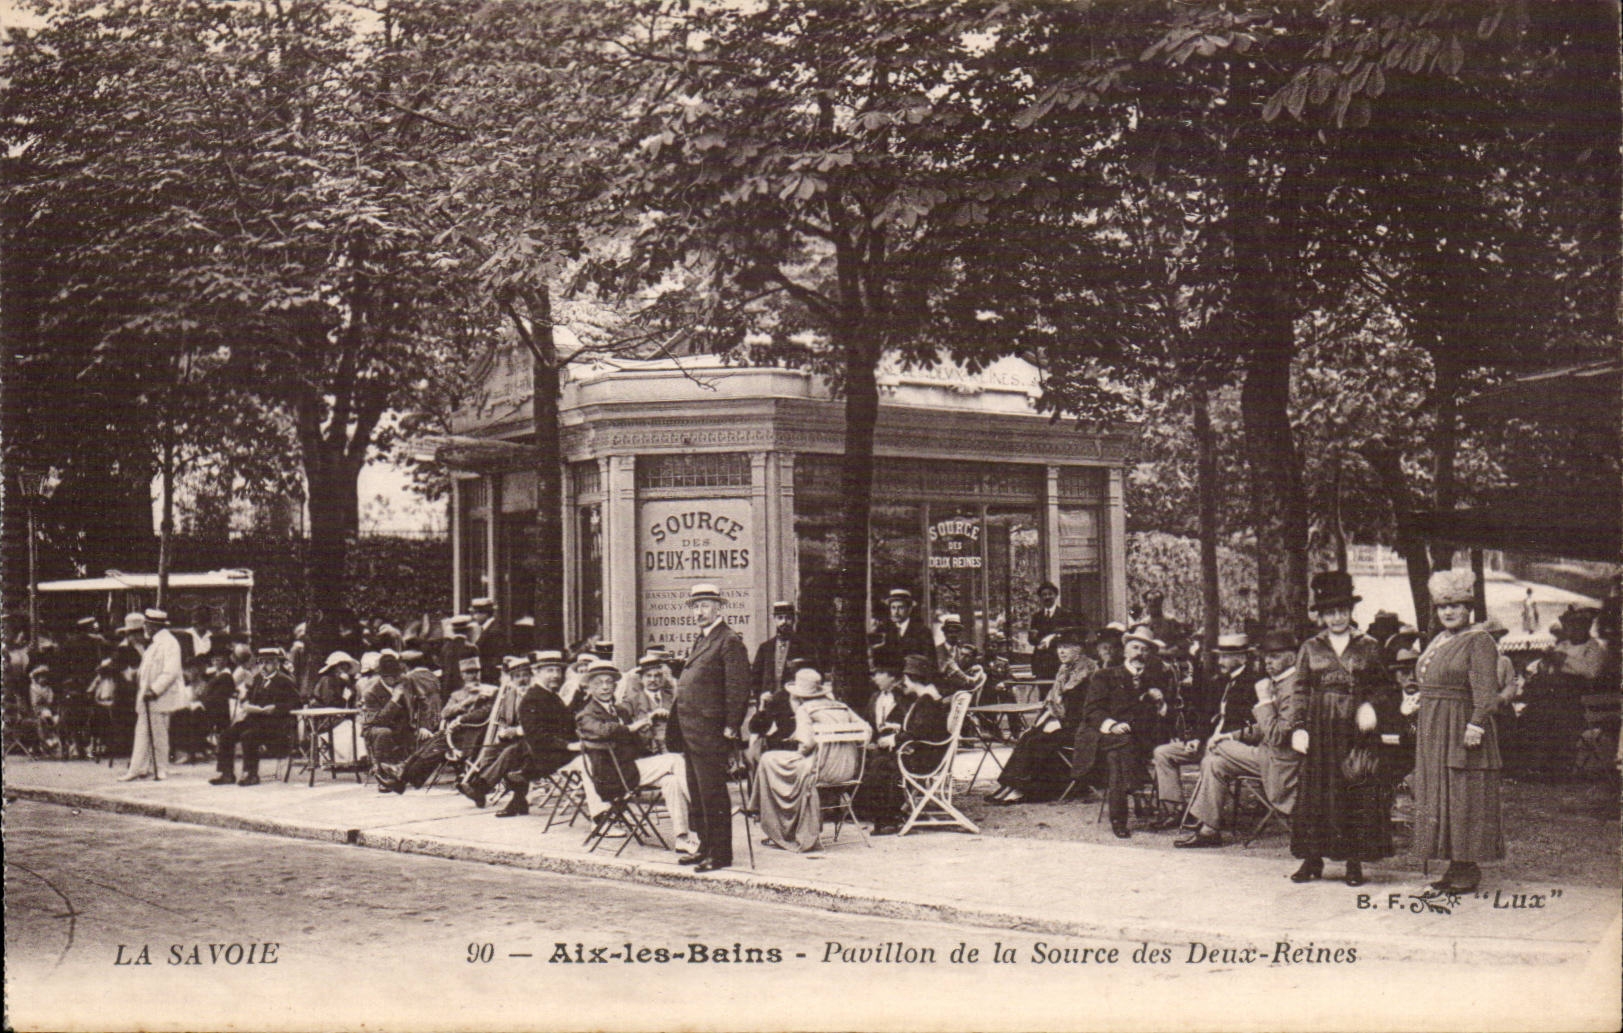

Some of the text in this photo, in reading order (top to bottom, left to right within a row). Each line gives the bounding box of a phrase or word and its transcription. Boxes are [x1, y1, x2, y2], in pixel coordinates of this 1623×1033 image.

[650, 511, 745, 542] SOURCE
[928, 520, 981, 541] SOURCE
[682, 538, 711, 548] DES
[948, 541, 962, 550] DES
[645, 548, 750, 572] DEUX-REINES
[928, 556, 982, 569] DEUX REINES
